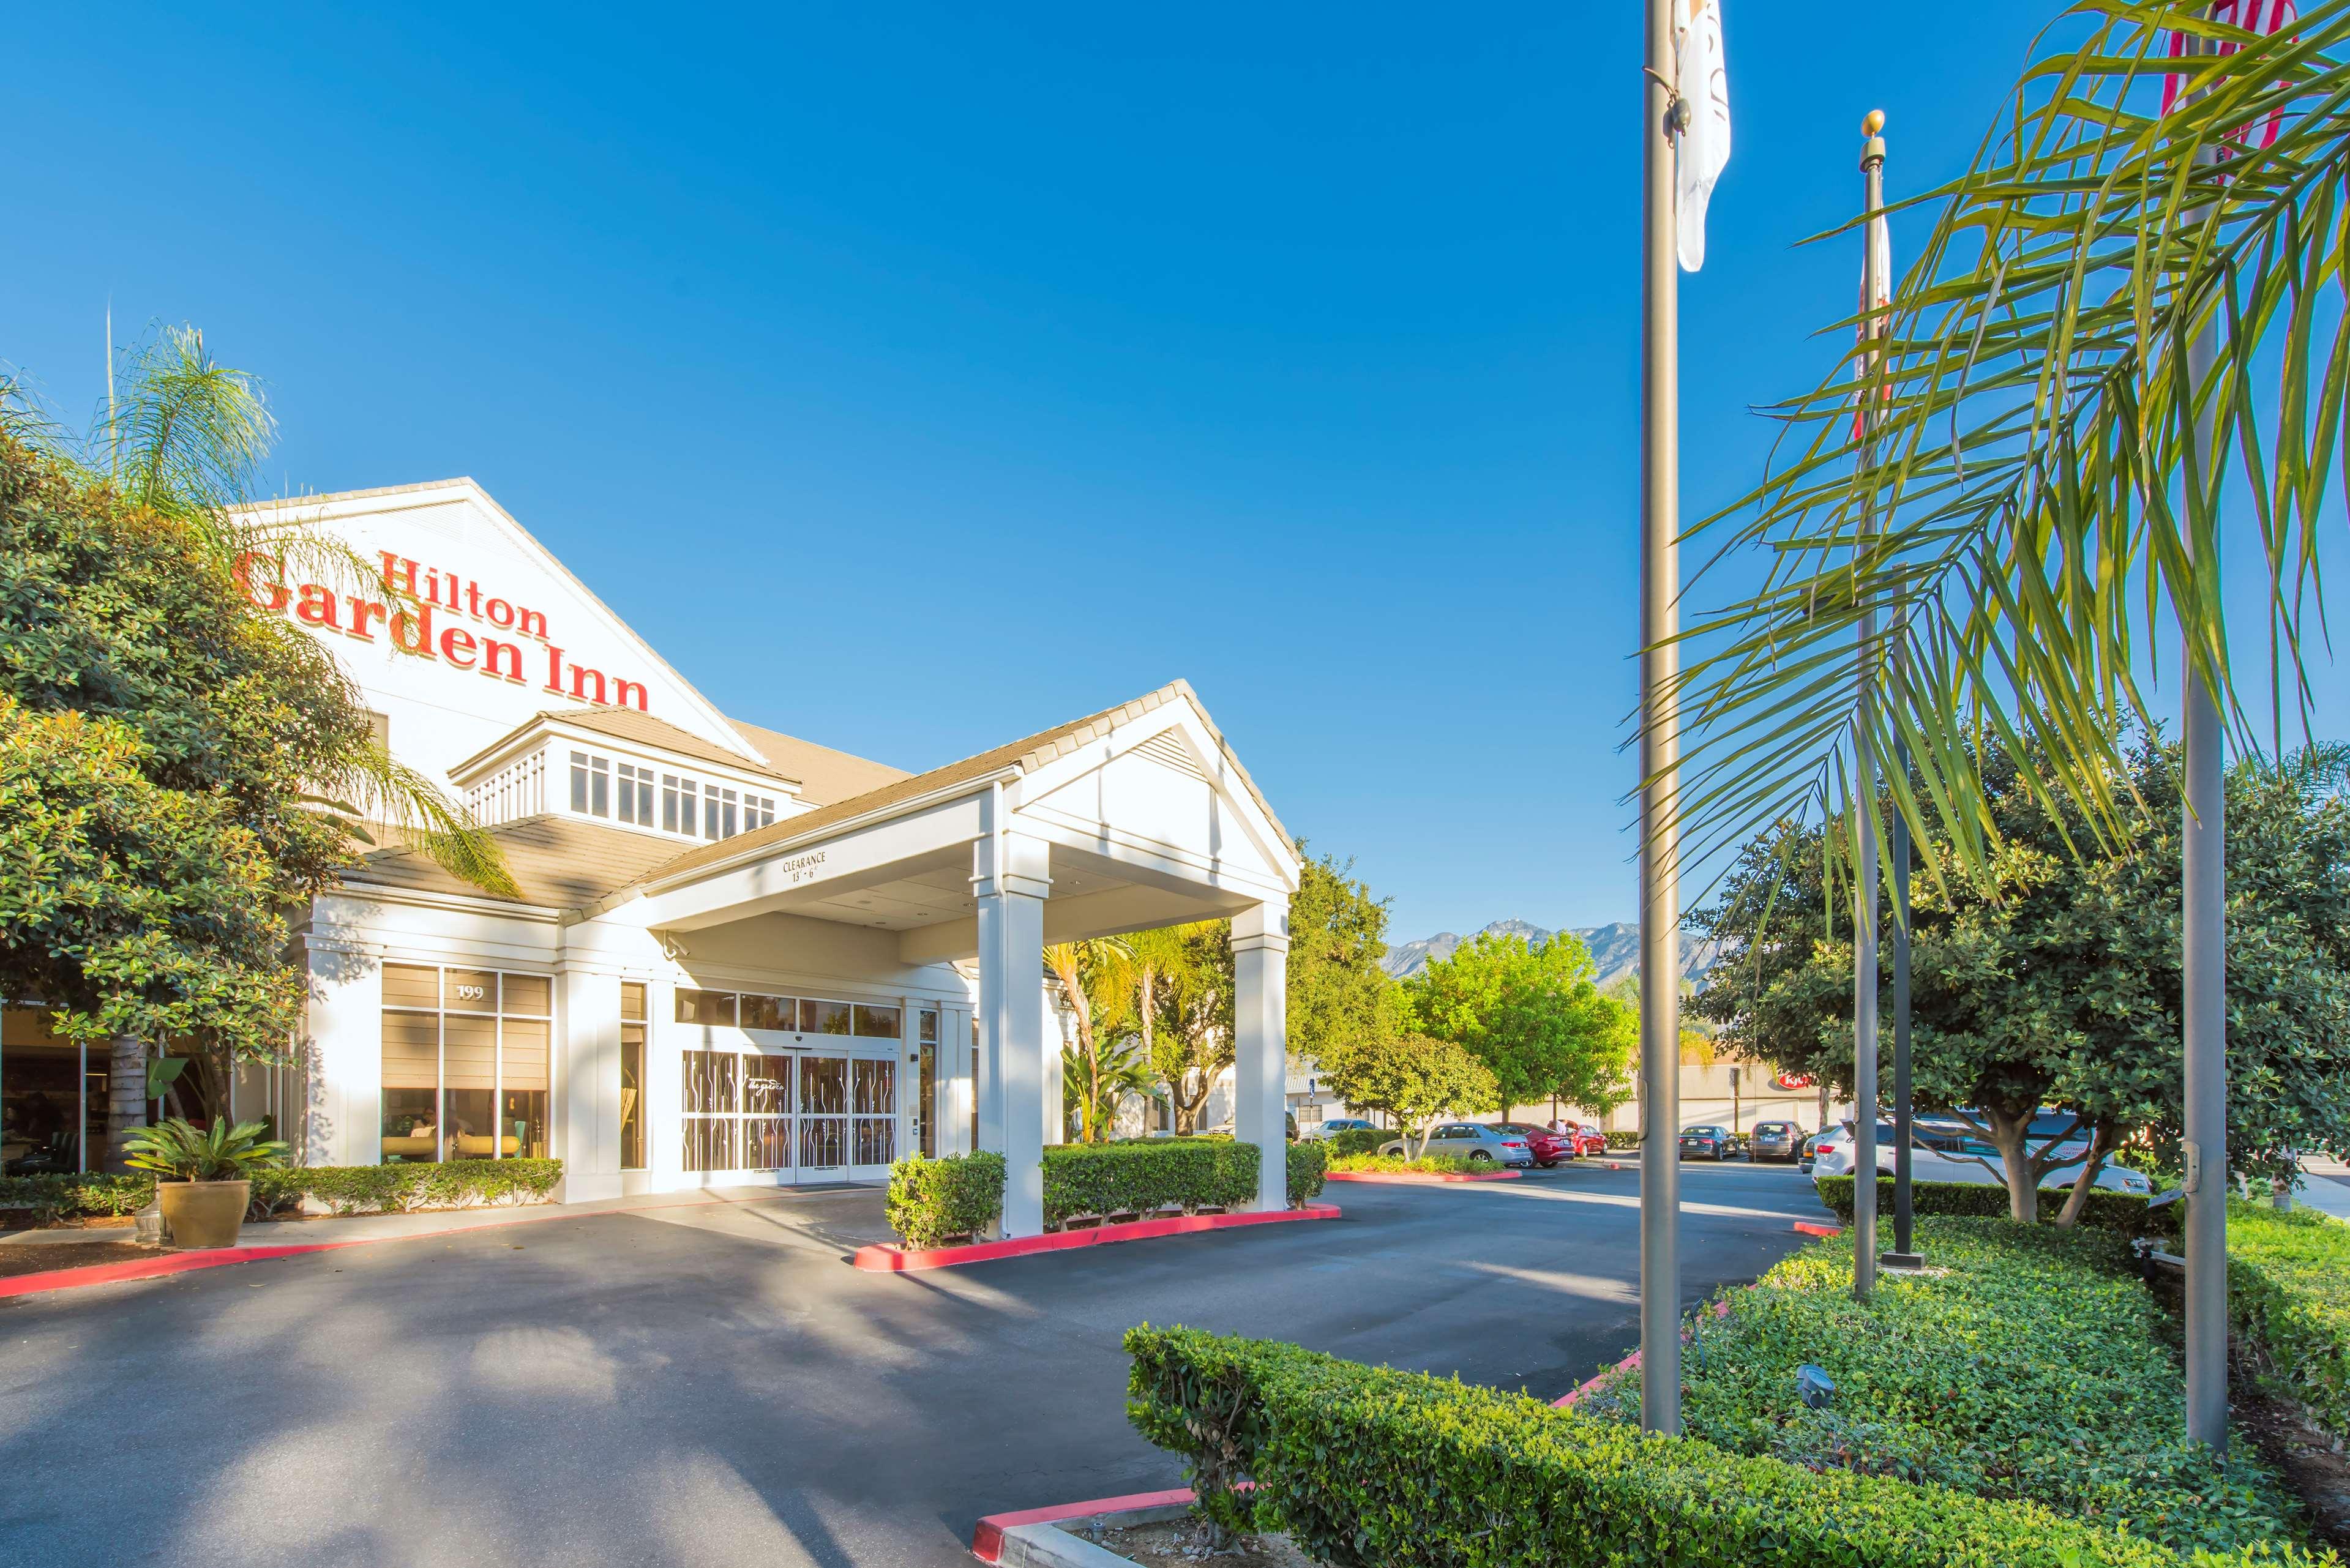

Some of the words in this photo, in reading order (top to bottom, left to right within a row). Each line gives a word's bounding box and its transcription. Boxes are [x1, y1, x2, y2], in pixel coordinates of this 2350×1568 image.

[378, 550, 550, 640] Hilton
[231, 550, 528, 684] Garden
[543, 643, 648, 711] Inn
[783, 851, 826, 872] CLEARANCE
[456, 985, 484, 999] 199
